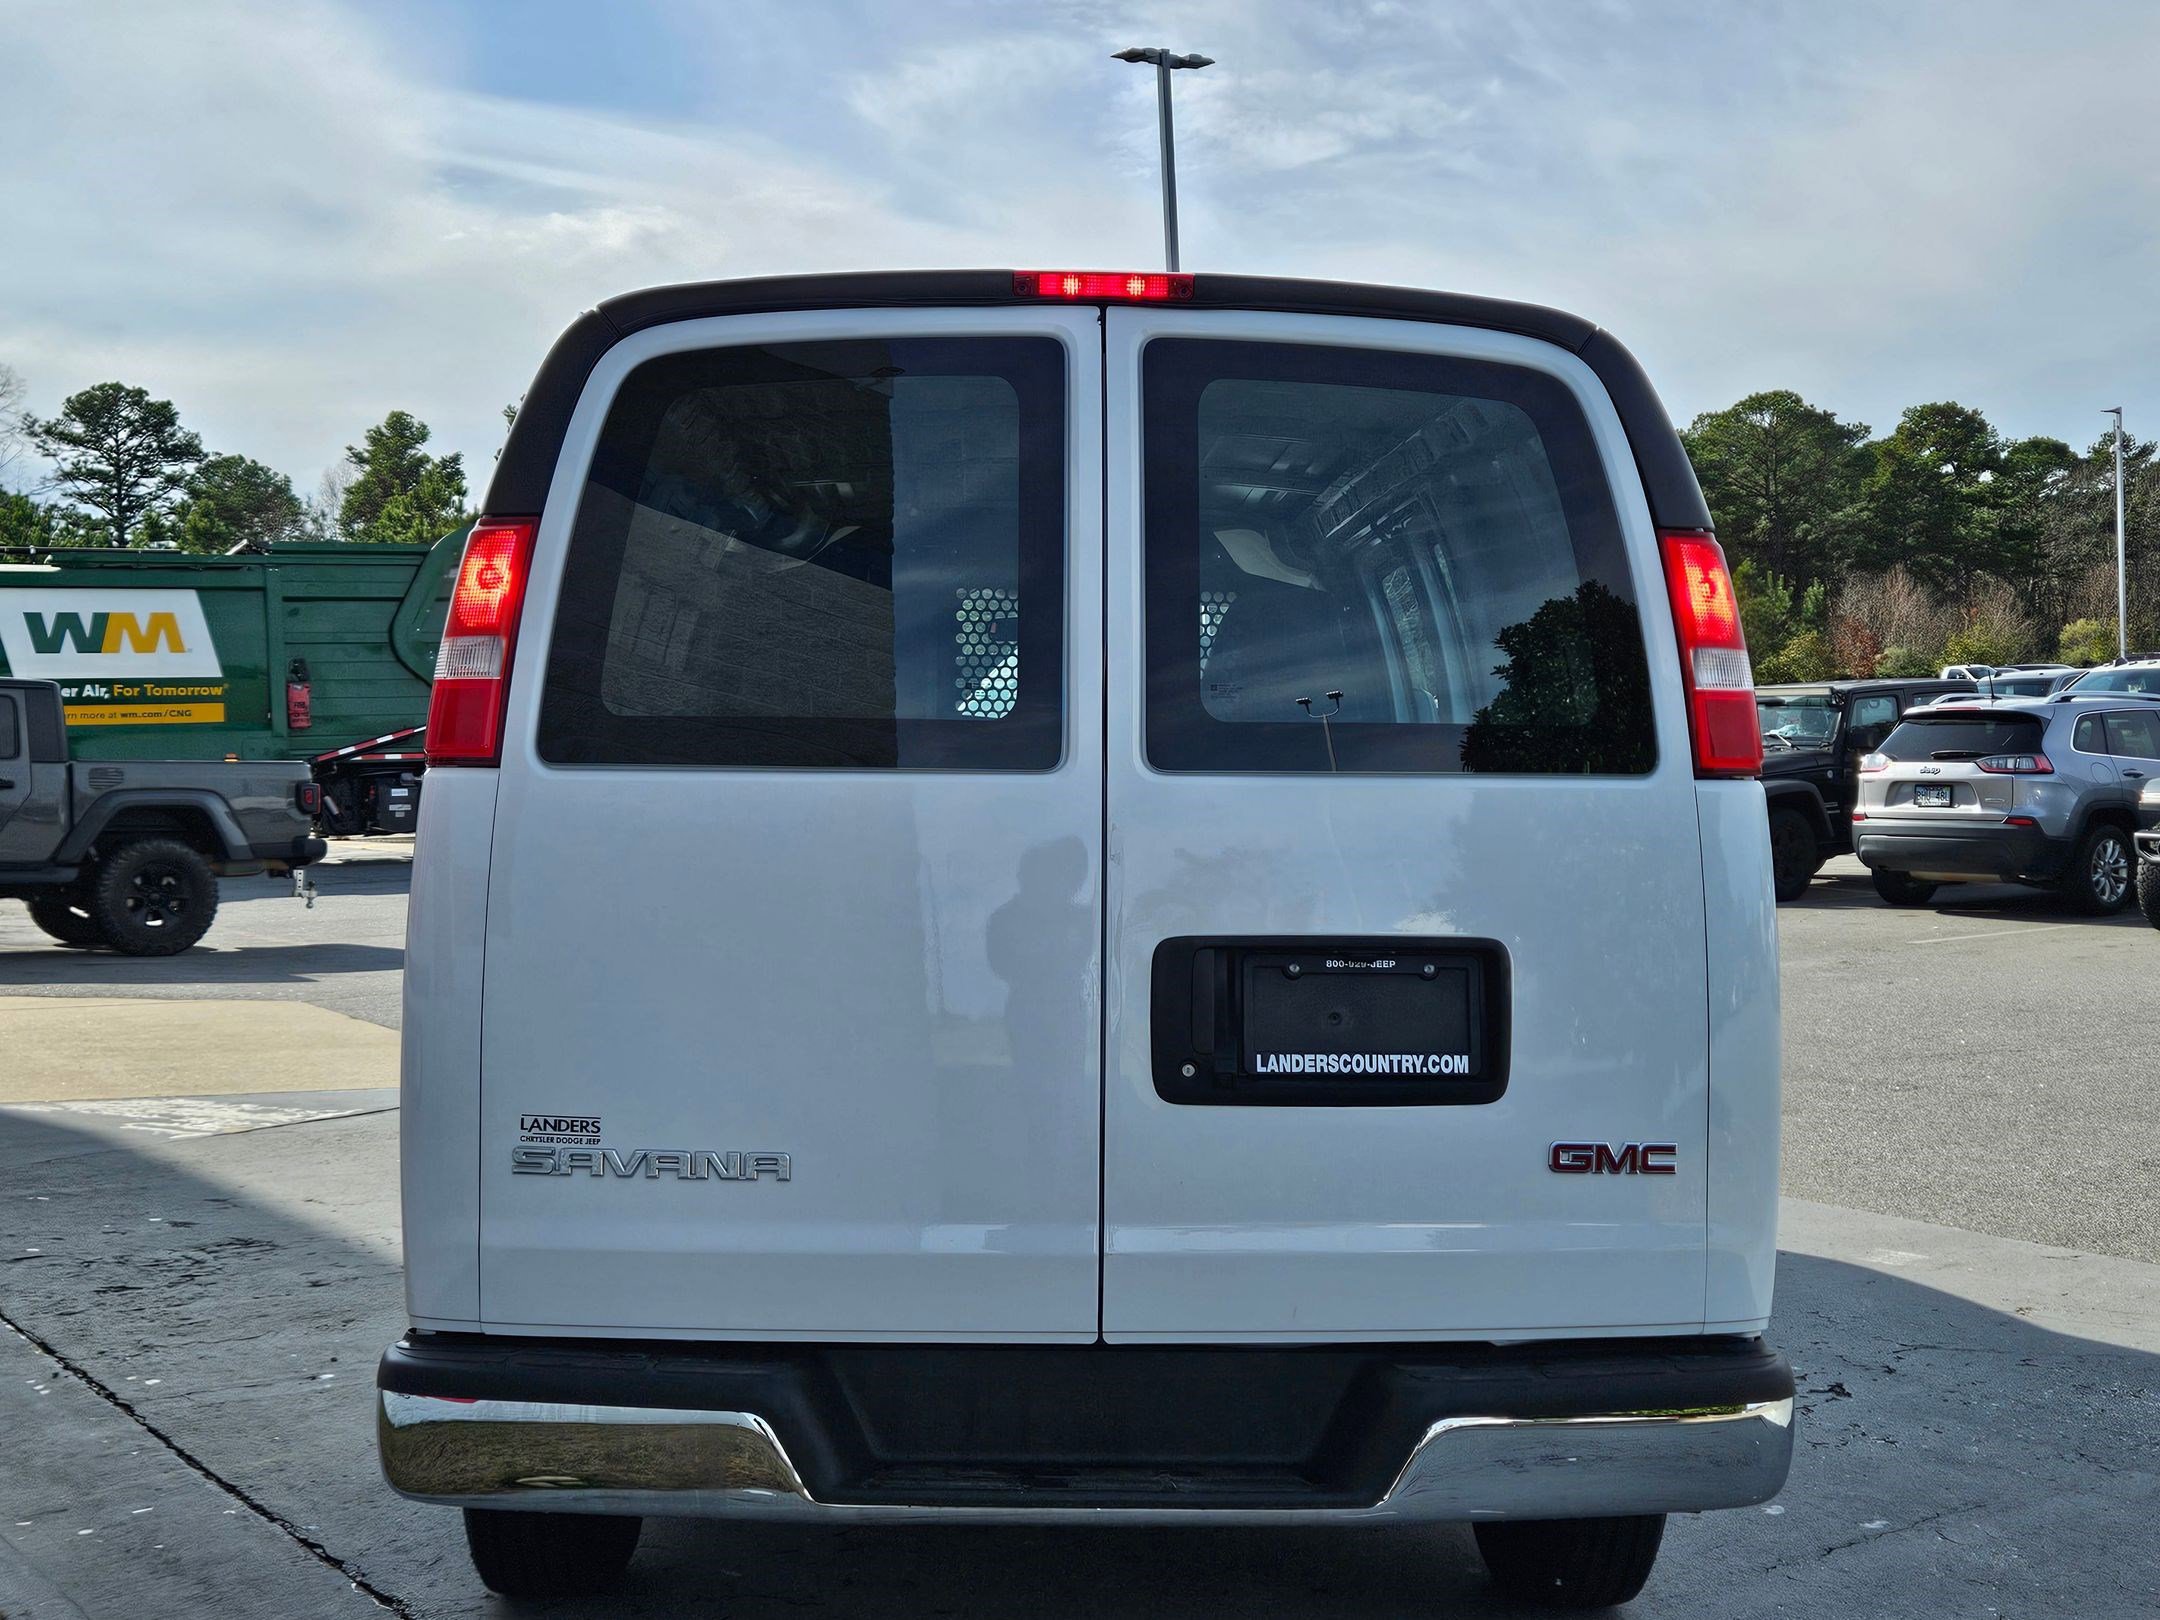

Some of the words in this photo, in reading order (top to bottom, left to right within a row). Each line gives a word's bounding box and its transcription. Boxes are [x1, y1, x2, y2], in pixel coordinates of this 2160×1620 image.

[23, 612, 186, 653] WM
[60, 686, 79, 697] er
[82, 684, 110, 699] Air,
[113, 684, 140, 696] For
[144, 683, 224, 697] Tomorrow
[80, 711, 106, 719] more
[120, 709, 192, 719] wm.com/CNG
[1256, 1054, 1469, 1074] LANDERSCOUNTRY.COM
[520, 1117, 601, 1134] LANDERS
[520, 1135, 555, 1144] CHRYSLER
[556, 1136, 583, 1145] DODGE
[585, 1137, 601, 1145] JEEP
[511, 1146, 791, 1182] SAVANA
[1549, 1140, 1678, 1174] GMC
